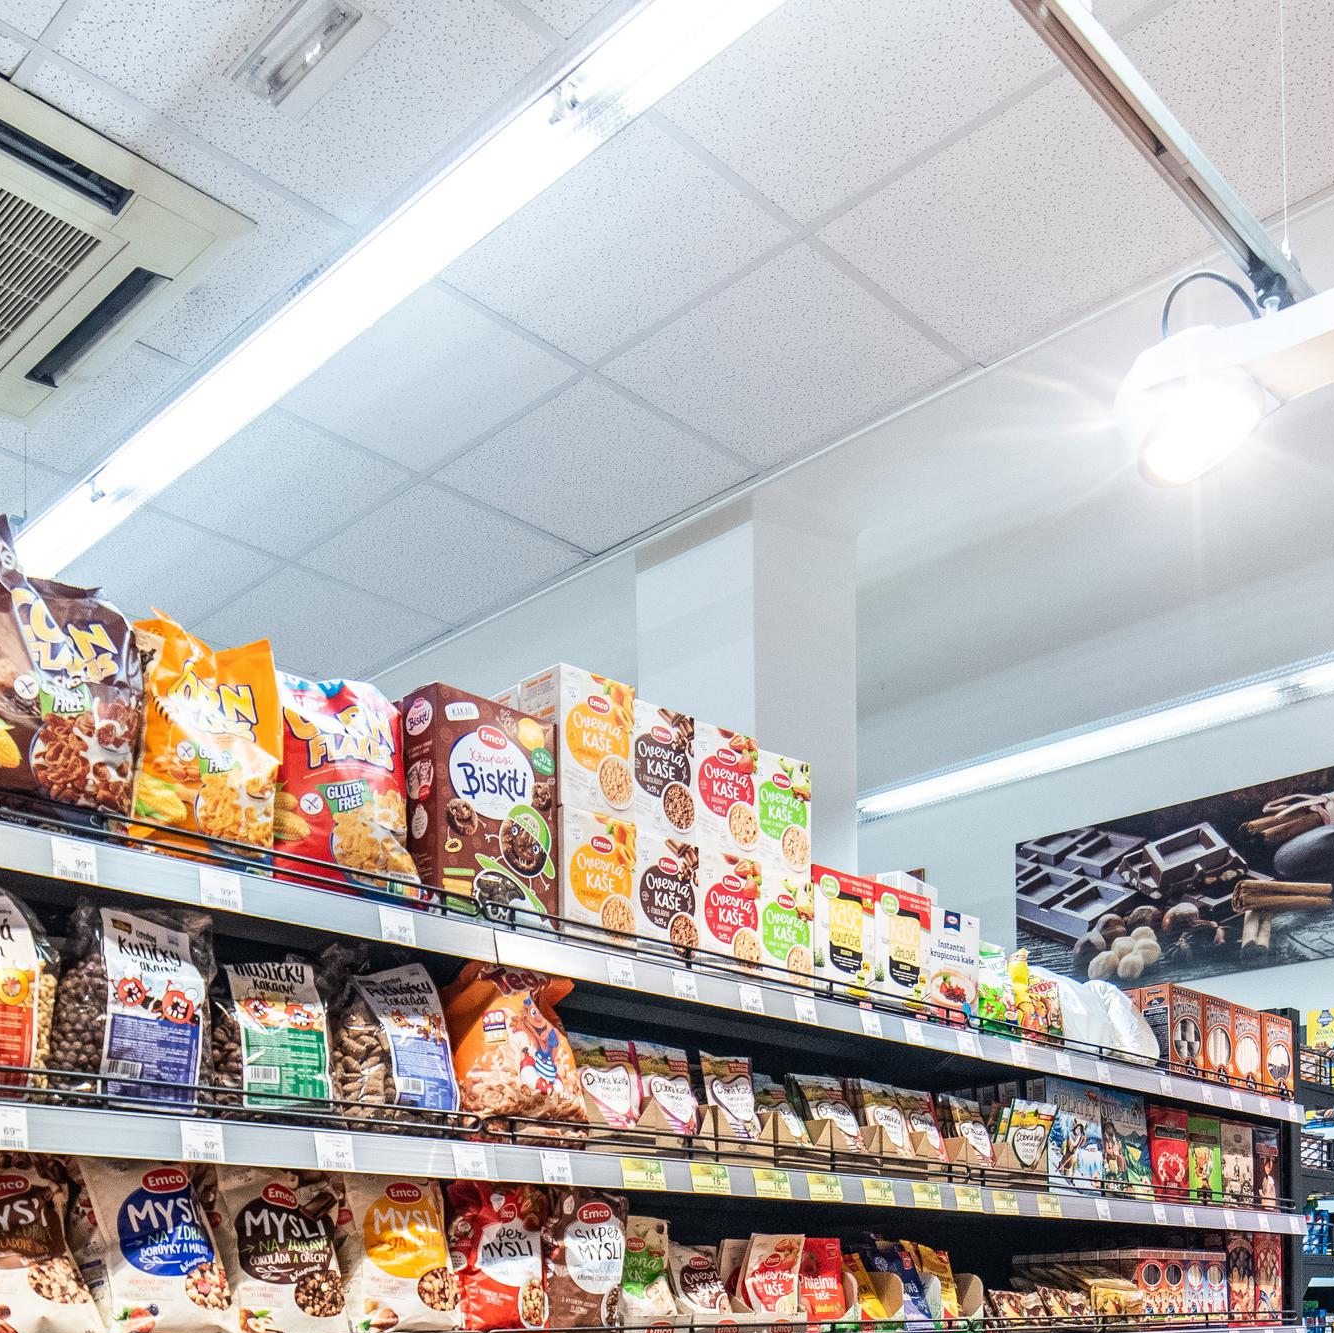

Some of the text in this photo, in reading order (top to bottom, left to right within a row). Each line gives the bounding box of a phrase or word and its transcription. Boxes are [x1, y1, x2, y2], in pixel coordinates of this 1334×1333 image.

[588, 697, 609, 712] Emco
[573, 710, 624, 737] Ovesná
[481, 730, 505, 746] Emco
[582, 732, 613, 754] KAŠE
[652, 728, 671, 741] Emco
[638, 741, 686, 769] Ovesná
[718, 751, 736, 762] Emco
[646, 758, 676, 781] KAŠE
[705, 762, 750, 788] Ovesná
[326, 780, 366, 799] GLUTEN
[457, 763, 527, 802] Biskiti
[712, 779, 740, 800] KAŠE
[773, 775, 791, 788] Emco
[338, 794, 363, 812] FREE
[768, 802, 795, 824] KAŠE
[592, 838, 612, 852] Emco
[576, 852, 626, 880] Ovesná
[660, 859, 678, 872] Emco
[585, 874, 616, 894] KAŠE
[645, 872, 691, 898] Ovesná
[723, 877, 741, 888] Emco
[654, 888, 682, 911] KAŠE
[709, 890, 754, 915] Ovesná
[718, 908, 745, 927] KAŠE
[773, 927, 797, 943] KAŠE
[118, 936, 182, 967] Kuličky
[938, 939, 966, 952] Instantní
[930, 948, 975, 965] krupicová kaše
[147, 1171, 185, 1187] Emco
[266, 1187, 296, 1207] Emco
[389, 1187, 419, 1200] Emco
[583, 1210, 610, 1220] Emco
[244, 1208, 326, 1243] MYSLI
[258, 1240, 281, 1252] NA
[579, 1243, 622, 1260] MYSLI
[248, 1251, 290, 1266] ČOKOLÁDA
[293, 1254, 299, 1263] A
[691, 1258, 707, 1267] Emco
[764, 1281, 785, 1296] KAŠE
